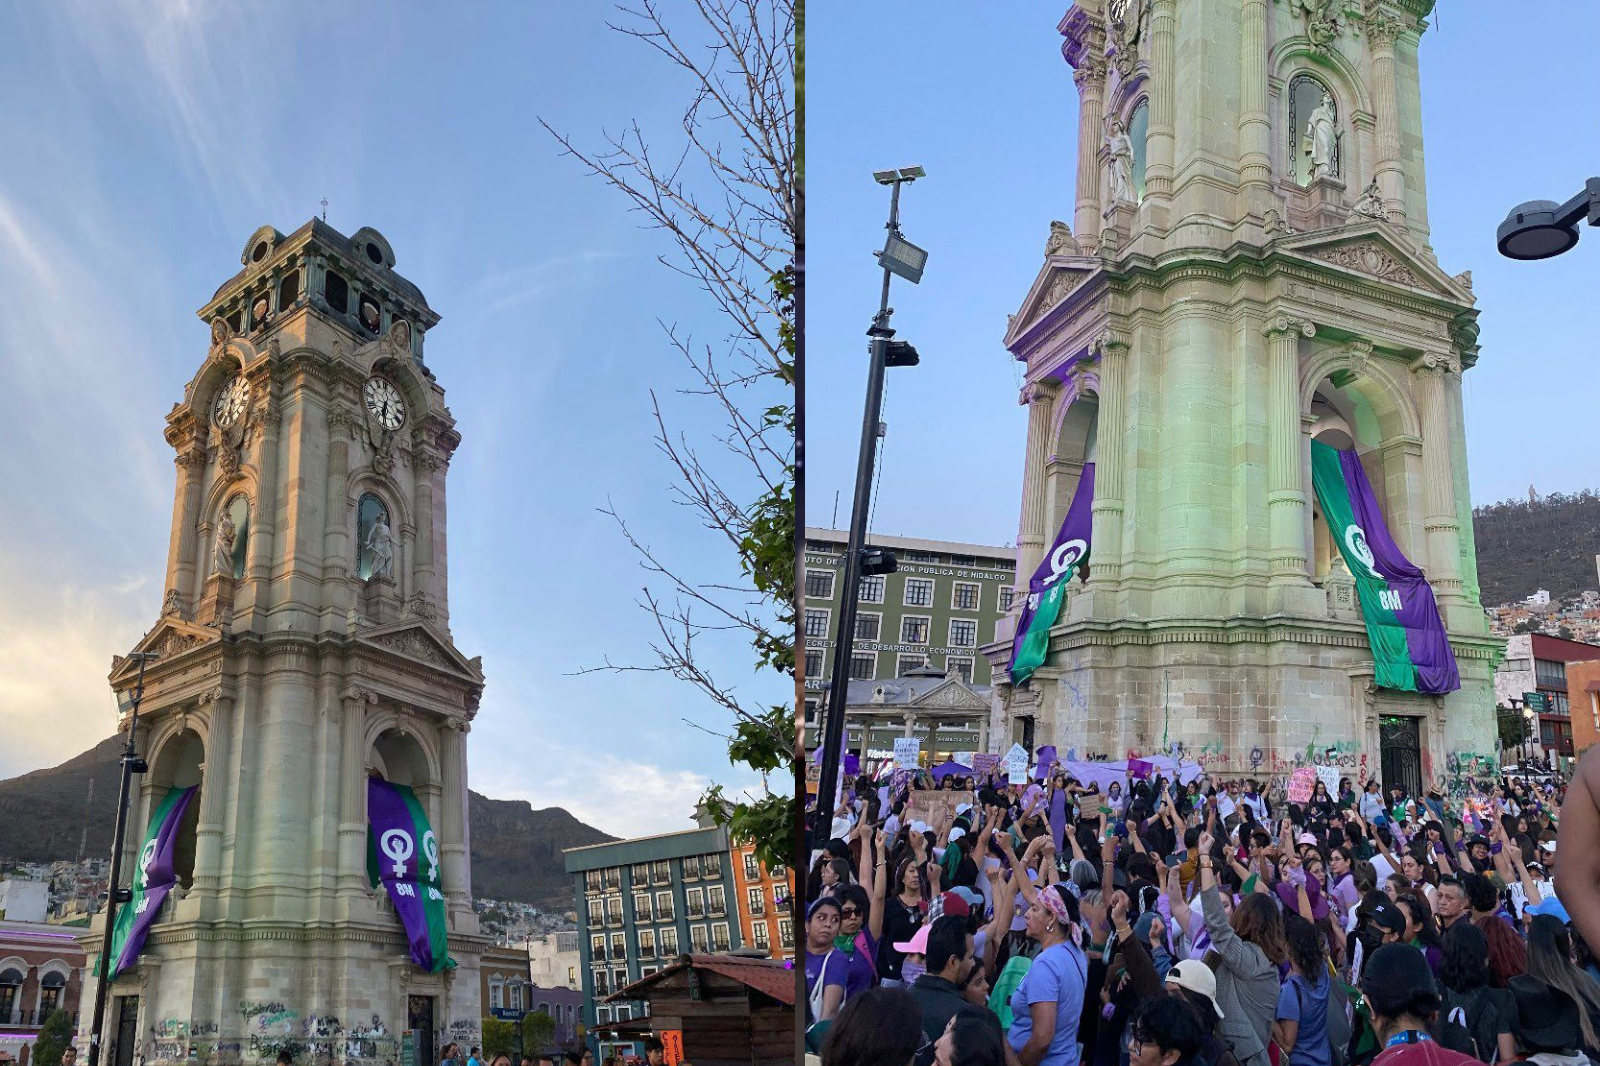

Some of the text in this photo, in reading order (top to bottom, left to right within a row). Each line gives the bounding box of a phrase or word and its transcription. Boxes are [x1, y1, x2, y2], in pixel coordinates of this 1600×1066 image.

[918, 566, 954, 577] PUBLICA
[957, 570, 968, 578] DE
[970, 571, 1006, 581] HIDALGO
[858, 642, 869, 650] DE
[871, 643, 926, 653] DESARROLLO
[929, 647, 975, 656] ECONOMICO
